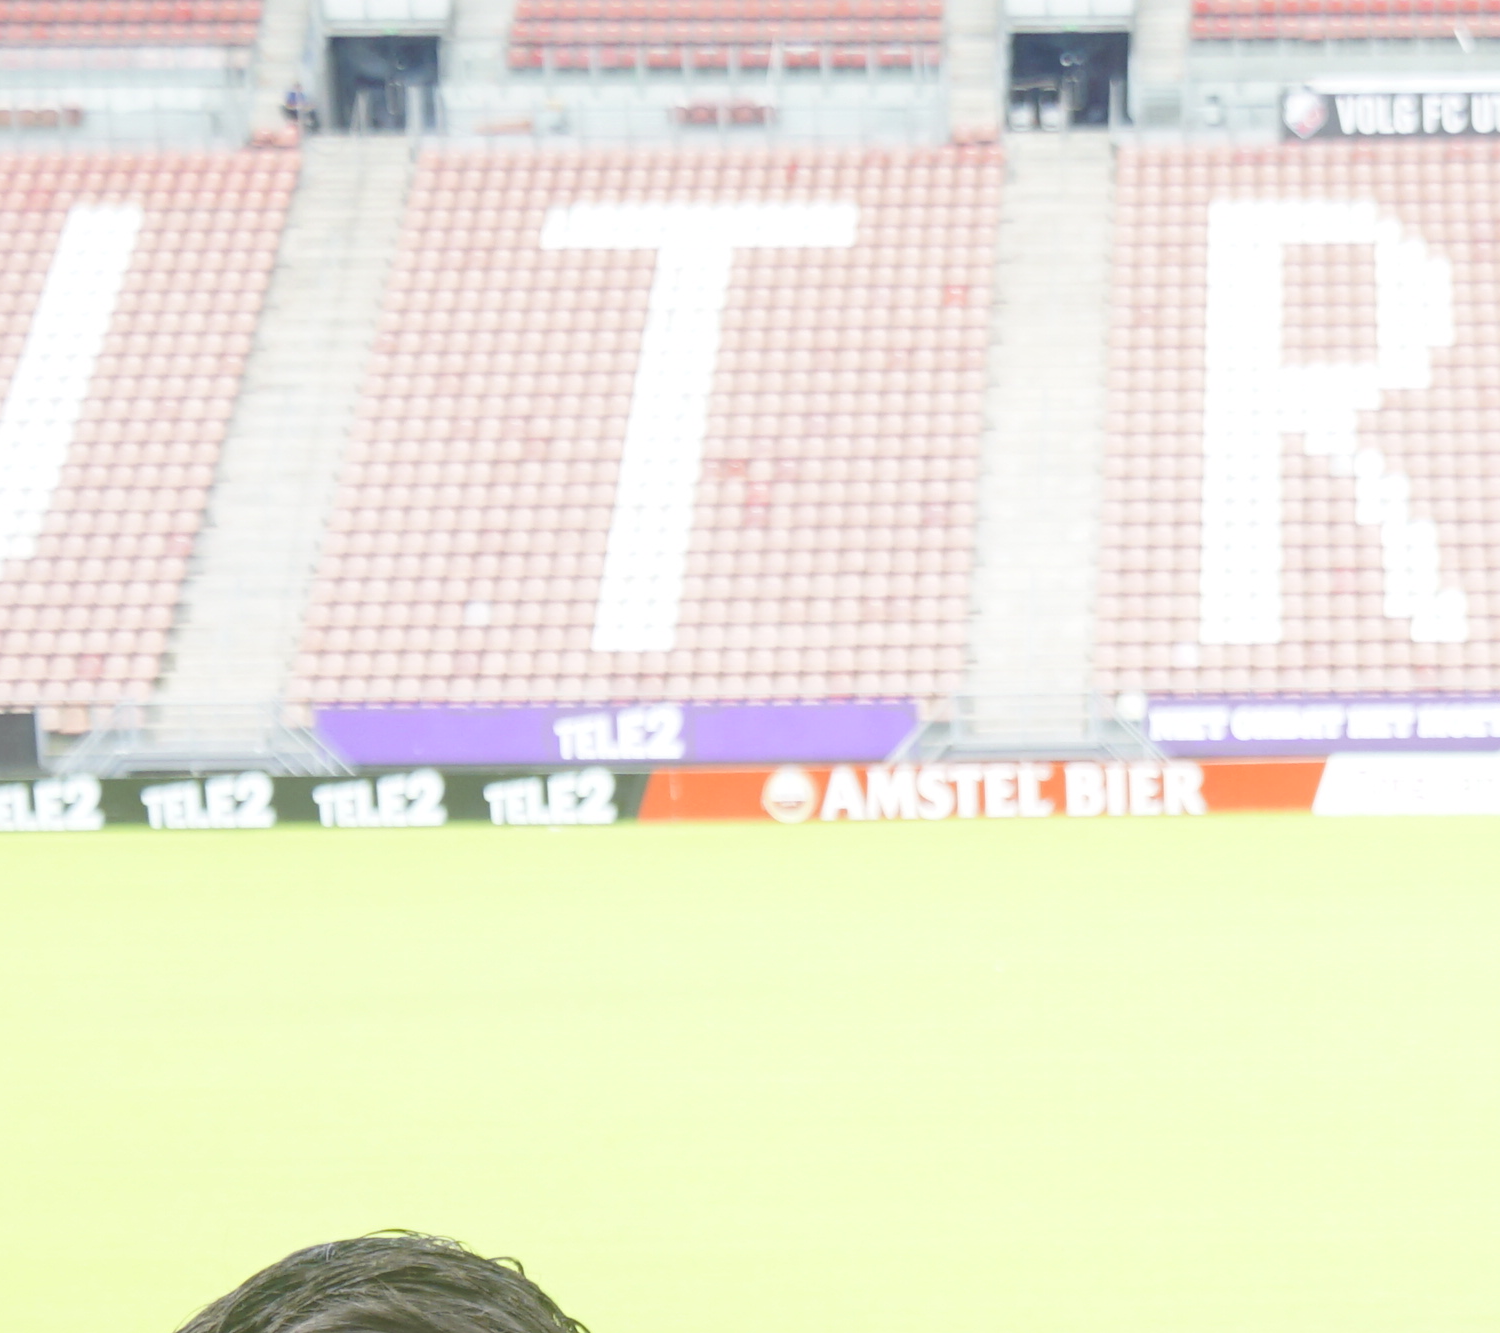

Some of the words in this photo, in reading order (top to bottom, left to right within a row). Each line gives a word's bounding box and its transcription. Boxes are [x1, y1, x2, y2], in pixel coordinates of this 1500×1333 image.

[1334, 92, 1420, 135] VOLG
[1422, 92, 1468, 135] FC
[553, 702, 686, 762] TELE2
[141, 770, 277, 830] TELE2
[312, 767, 448, 828] TELE2
[483, 766, 619, 826] TELE2
[820, 762, 1054, 822] AMSTEL
[1062, 758, 1209, 817] BIER
